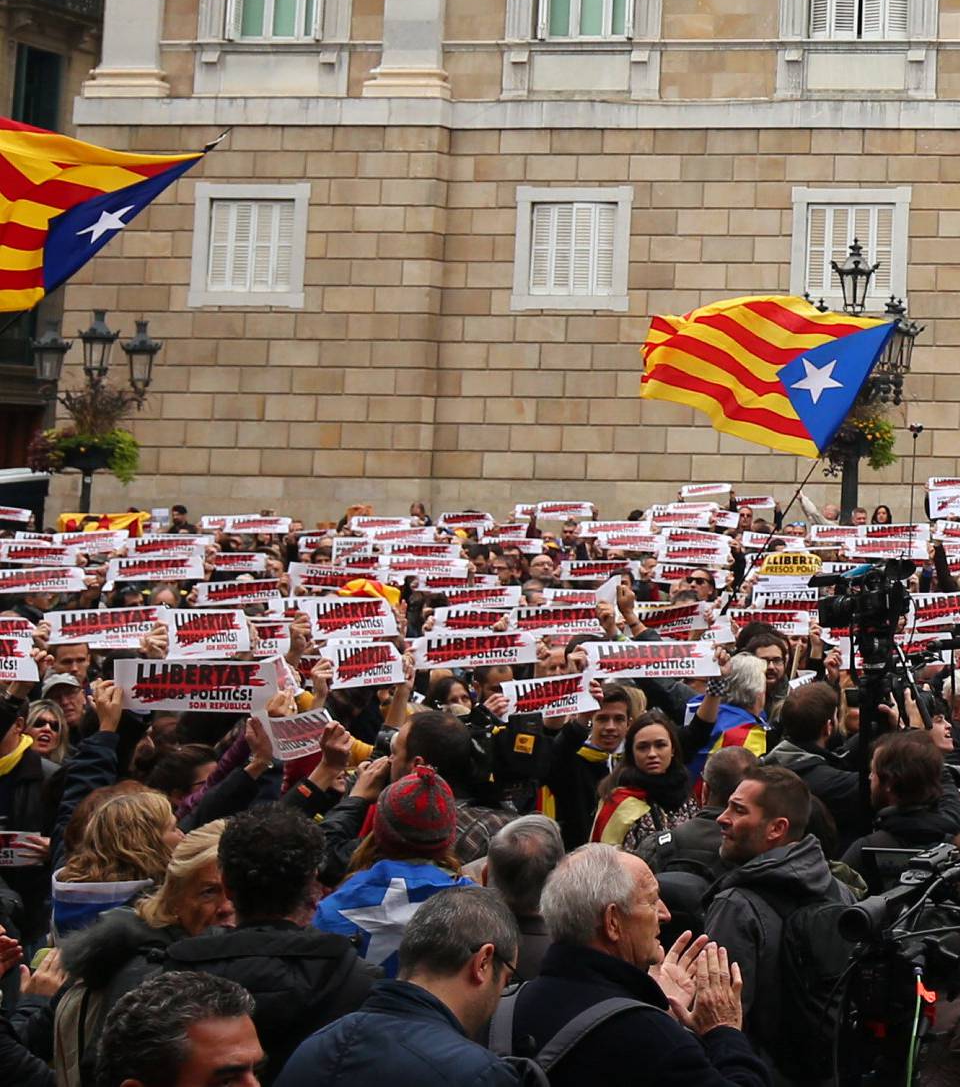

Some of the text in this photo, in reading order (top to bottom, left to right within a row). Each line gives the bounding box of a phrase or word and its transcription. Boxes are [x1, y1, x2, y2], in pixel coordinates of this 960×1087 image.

[61, 609, 156, 627] LLIBERTAT
[317, 601, 384, 620] LLIBERTAT
[175, 612, 237, 632] LLIBERTAT
[427, 634, 522, 653] LLIBERTAT
[597, 644, 698, 660] LLIBERTAT
[338, 645, 393, 666] LLIBERTAT
[136, 663, 252, 686] LLIBERTAT
[515, 677, 584, 699] LLIBERTAT
